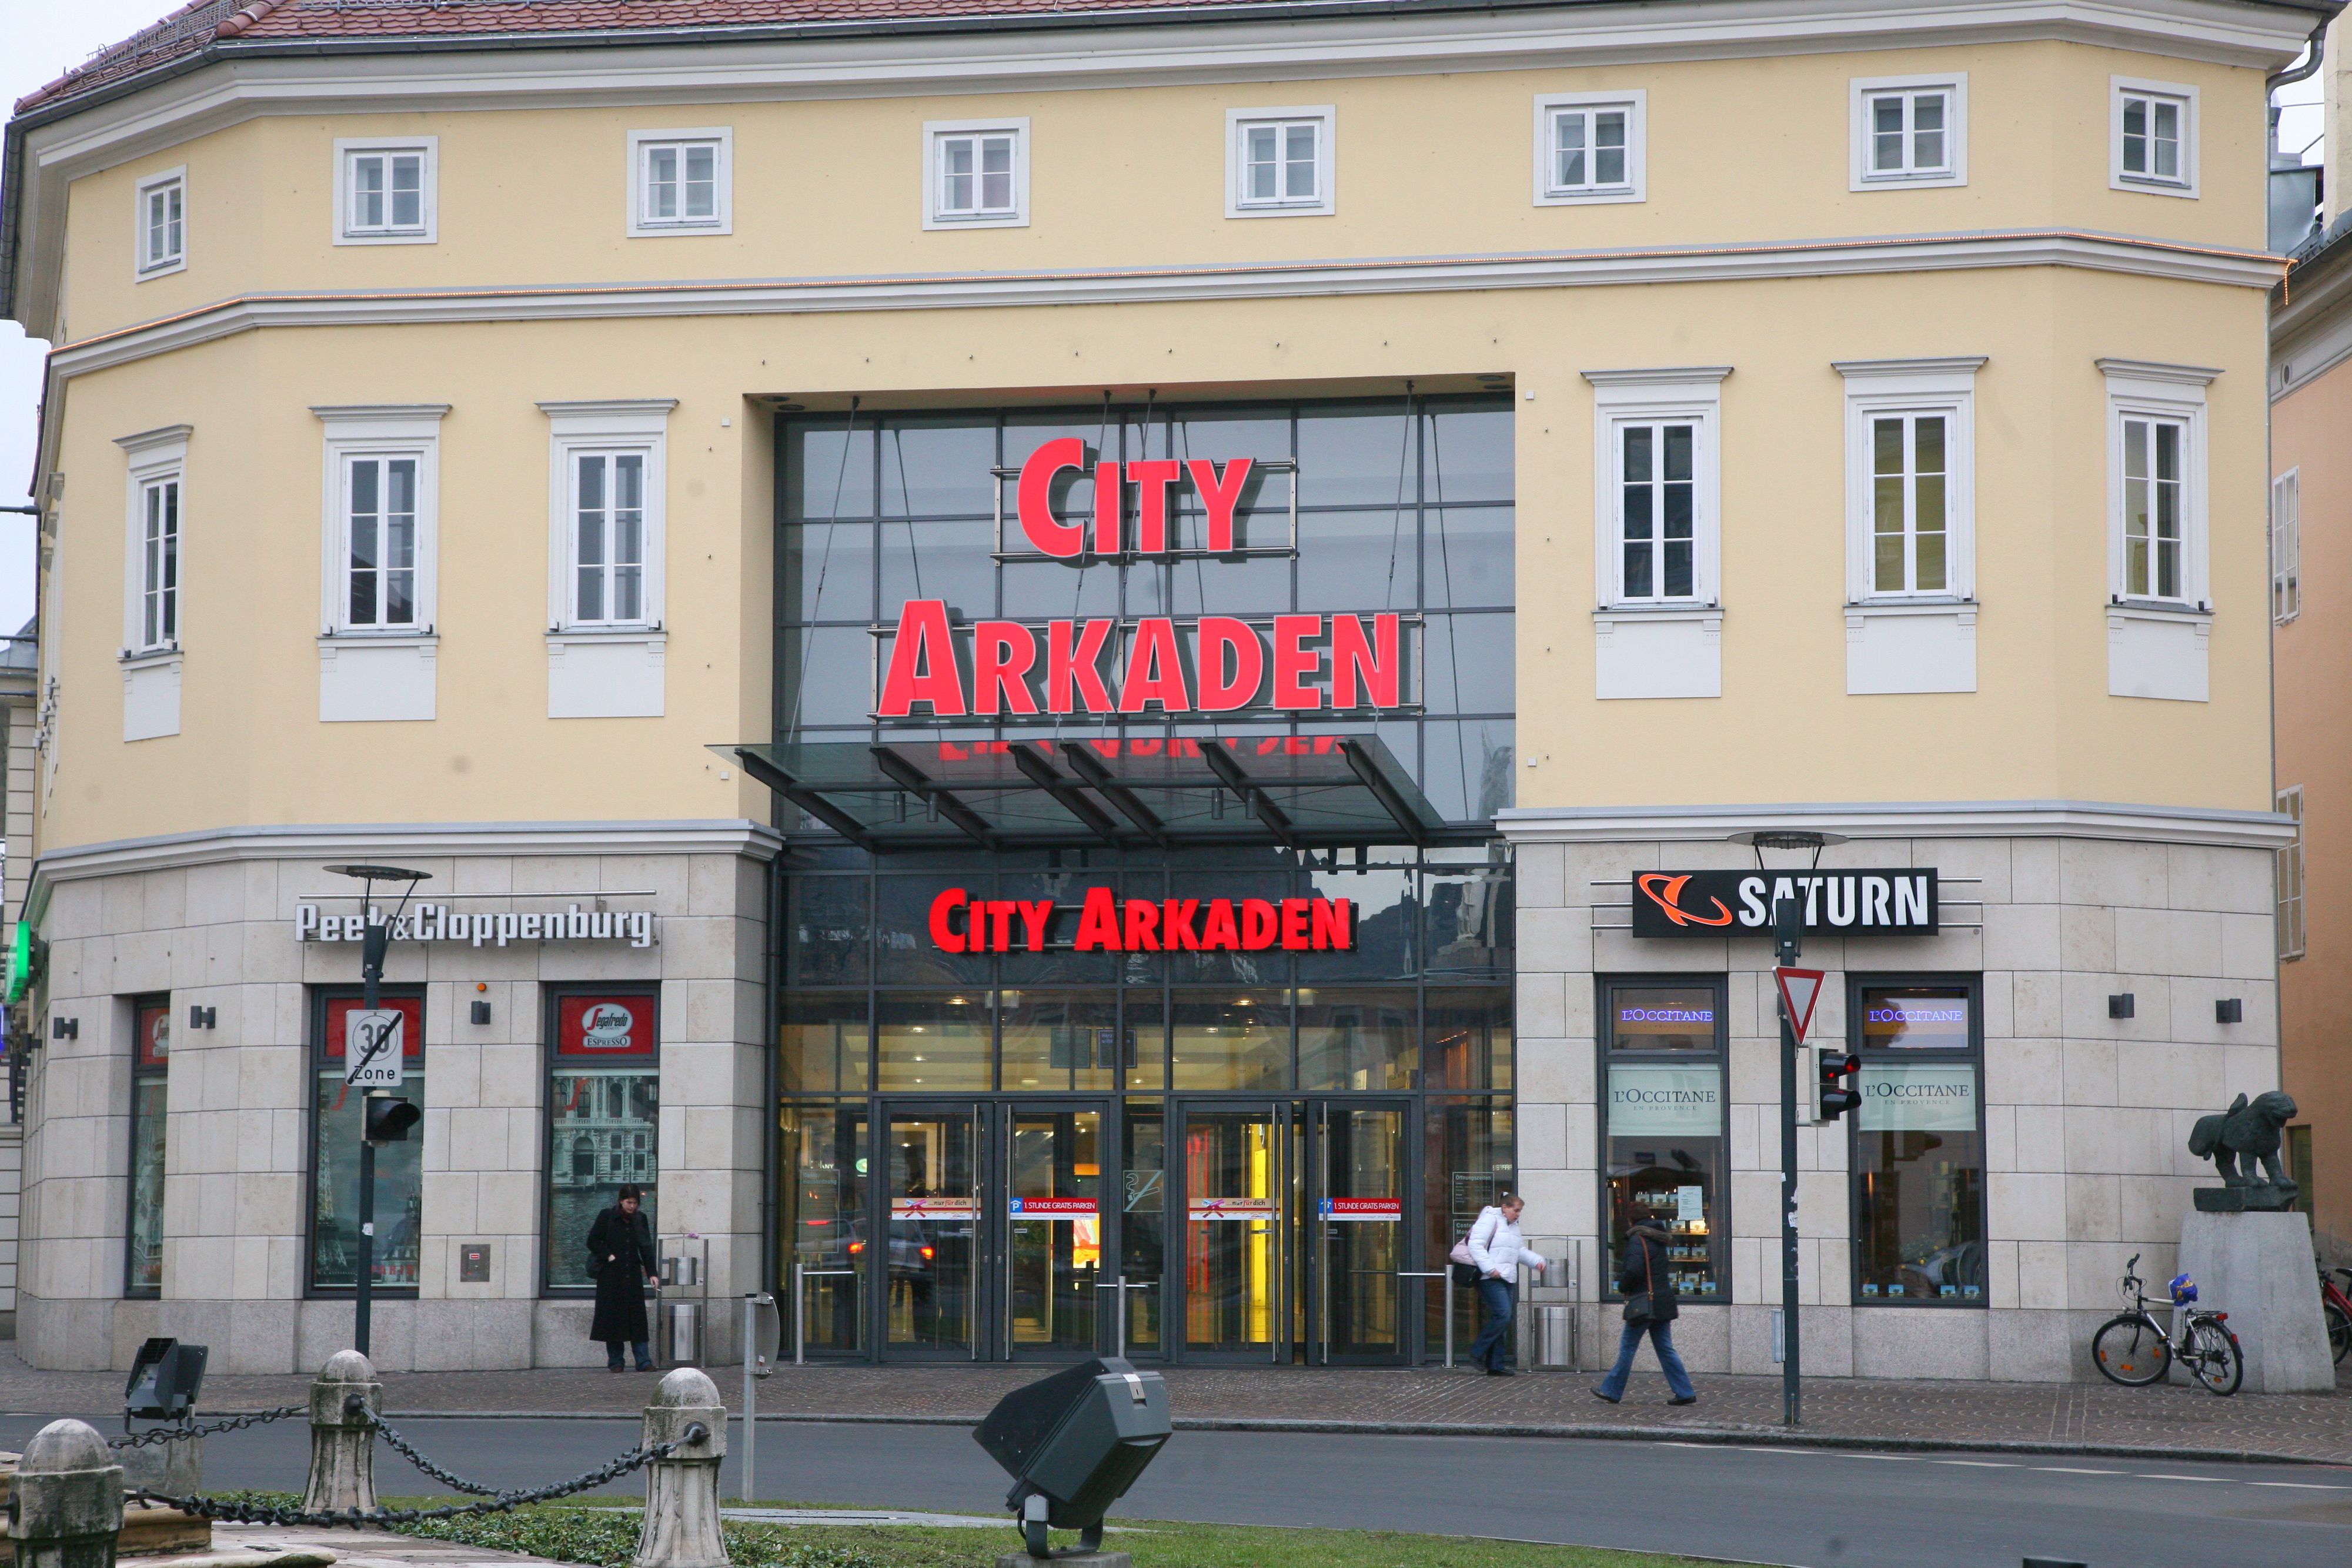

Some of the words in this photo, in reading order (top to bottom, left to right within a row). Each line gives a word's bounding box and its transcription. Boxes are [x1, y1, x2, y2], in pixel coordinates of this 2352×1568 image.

[1017, 437, 1256, 559] CITY
[877, 598, 1399, 717] ARKADEN
[928, 888, 1054, 953] CITY
[1074, 887, 1350, 951] ARKADEN
[360, 1024, 390, 1054] 30
[587, 1037, 627, 1046] ESPRESSO
[354, 1065, 395, 1079] Zone
[1614, 1088, 1716, 1103] L'OCCITANE
[1865, 1082, 1970, 1097] L'OCCITANE
